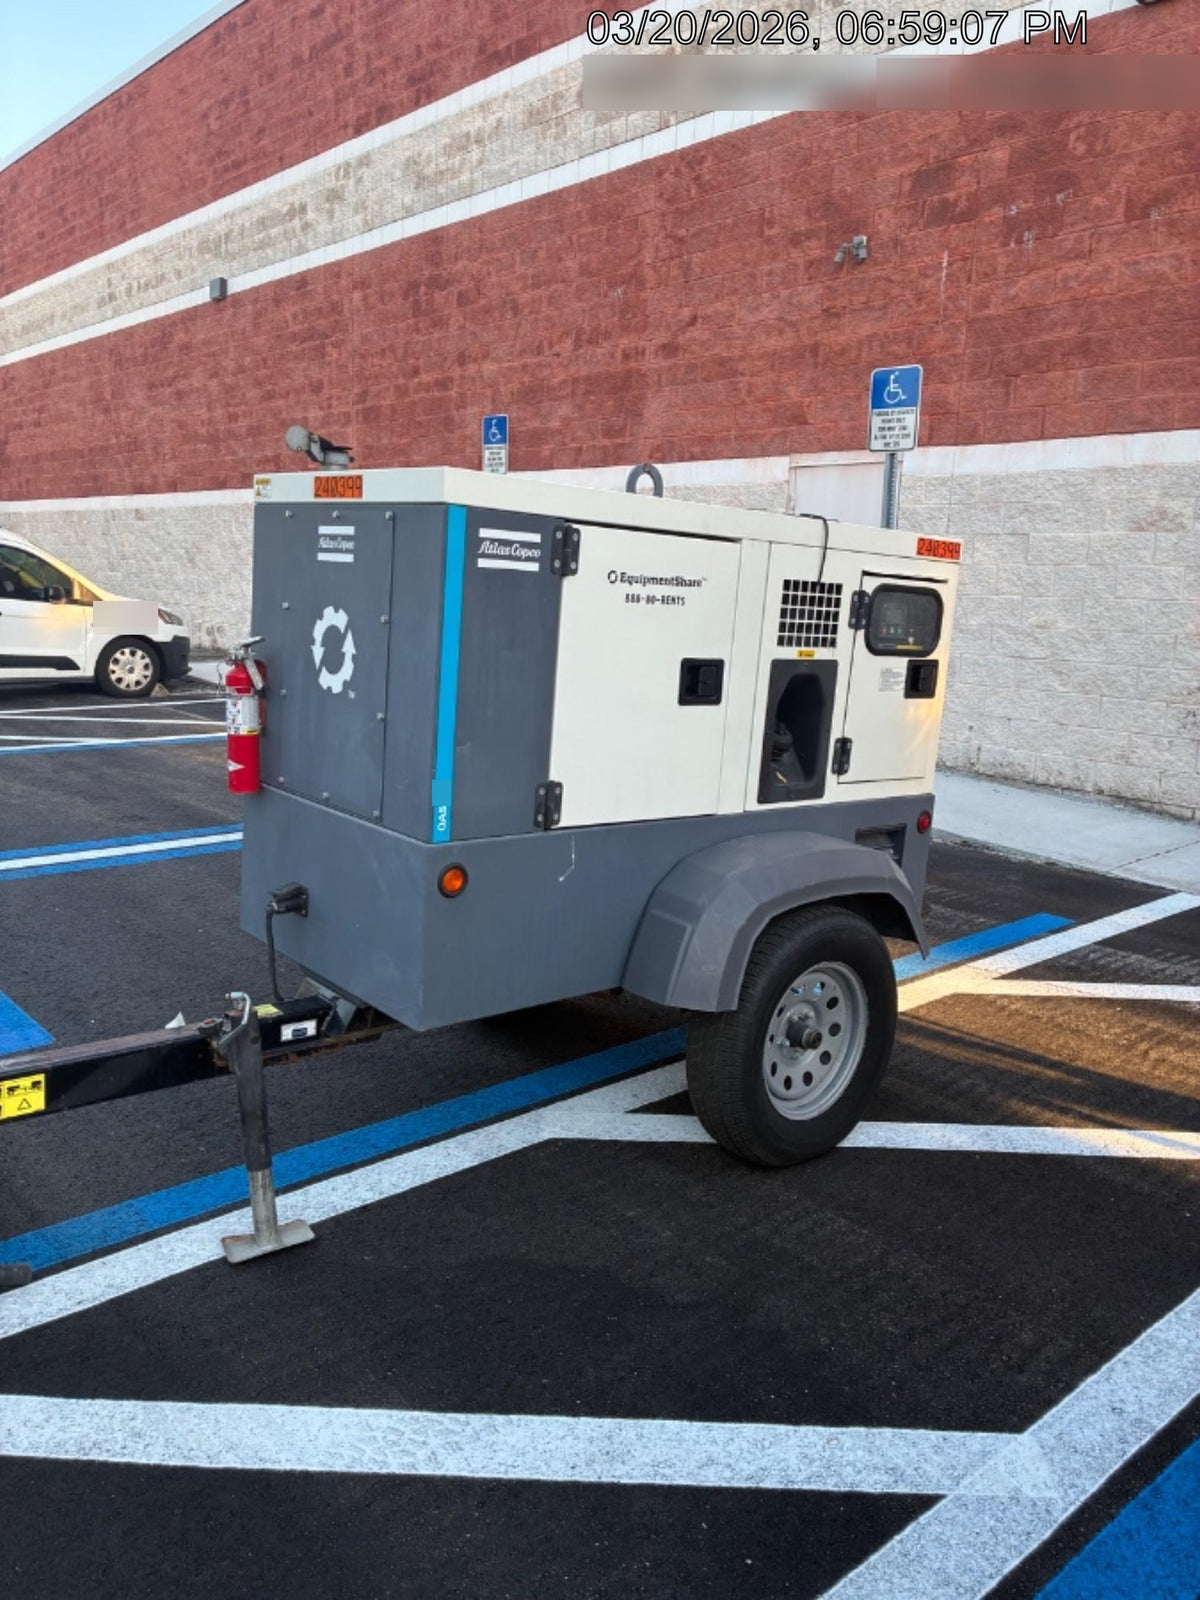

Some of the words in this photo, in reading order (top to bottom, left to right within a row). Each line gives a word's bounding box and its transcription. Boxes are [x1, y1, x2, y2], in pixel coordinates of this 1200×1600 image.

[478, 540, 510, 555] Atlas
[511, 543, 541, 560] Copco
[620, 571, 703, 588] EquipmentShare
